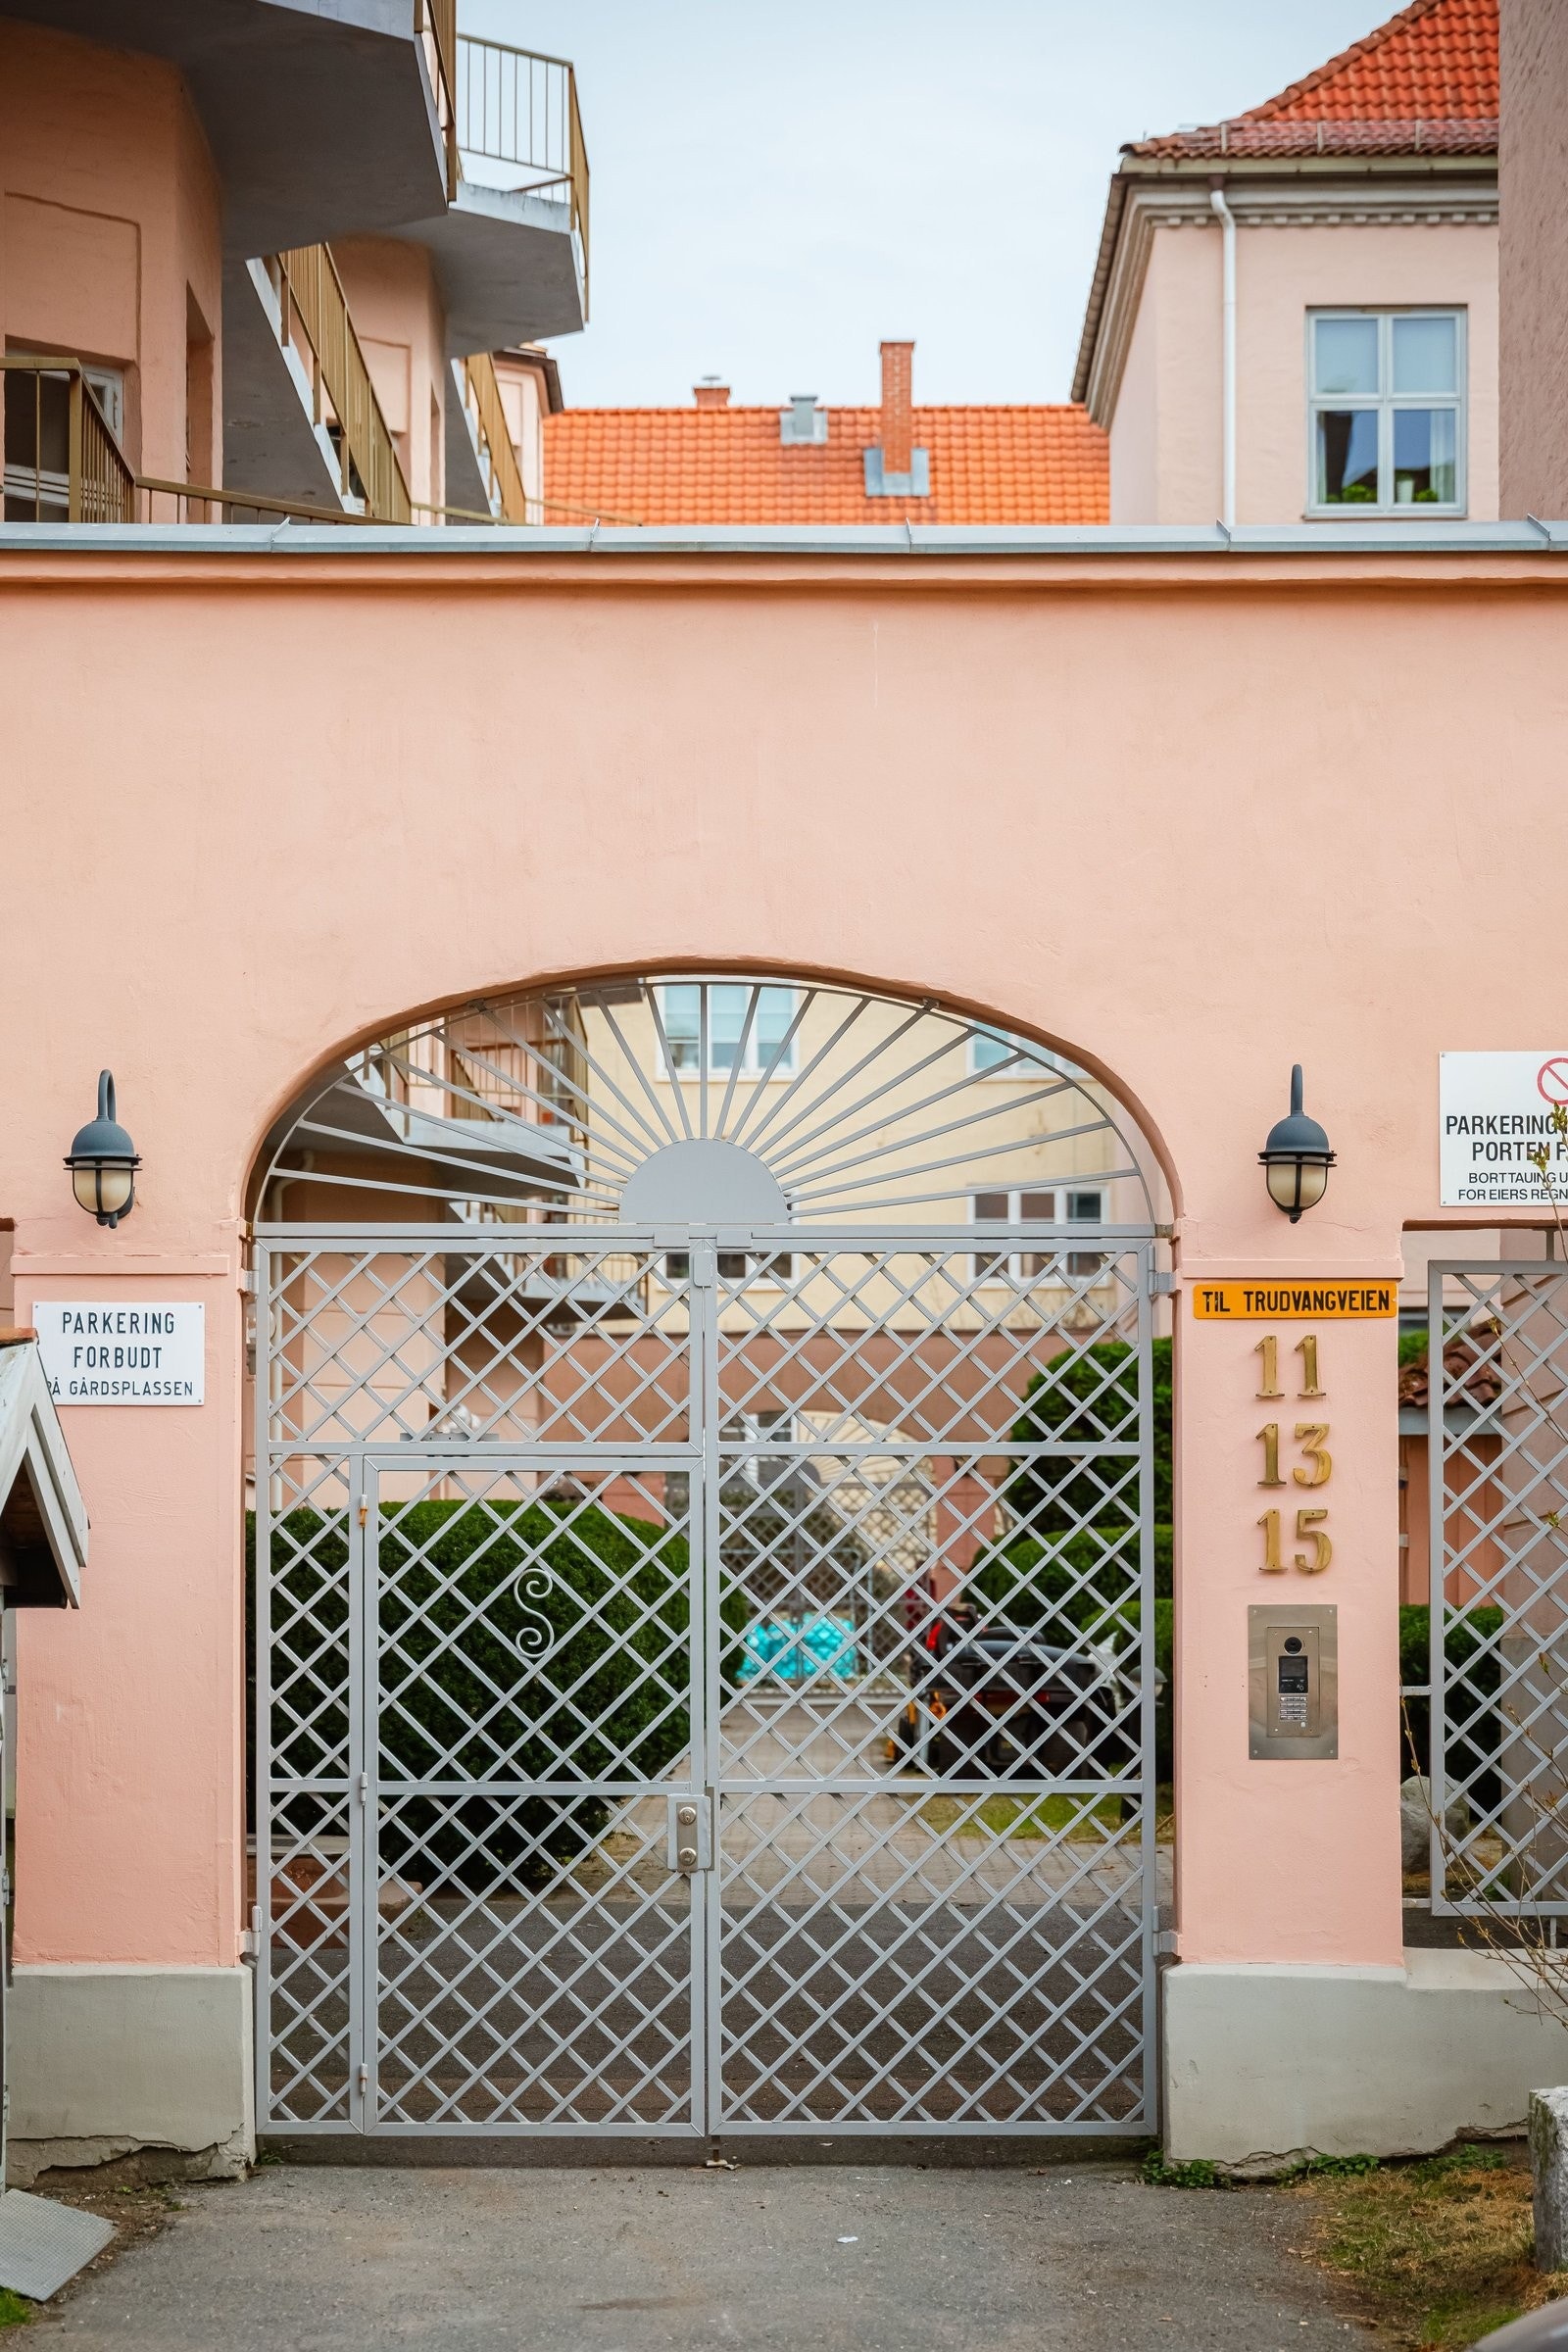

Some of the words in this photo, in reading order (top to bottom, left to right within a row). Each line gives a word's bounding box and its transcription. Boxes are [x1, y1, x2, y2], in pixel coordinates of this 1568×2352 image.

[1446, 1114, 1557, 1135] PARKERING
[1458, 1189, 1486, 1200] FOR
[1489, 1189, 1528, 1200] EIERS
[1202, 1291, 1231, 1312] TIL
[1243, 1290, 1390, 1311] TRUDVANGVEIEN
[62, 1311, 175, 1334] PARKERING
[74, 1347, 163, 1368] FORBUDT
[1254, 1335, 1326, 1397] 11
[70, 1376, 193, 1396] GÅRDSPLASSEN
[1255, 1423, 1333, 1486] 13
[1256, 1508, 1333, 1573] 15
